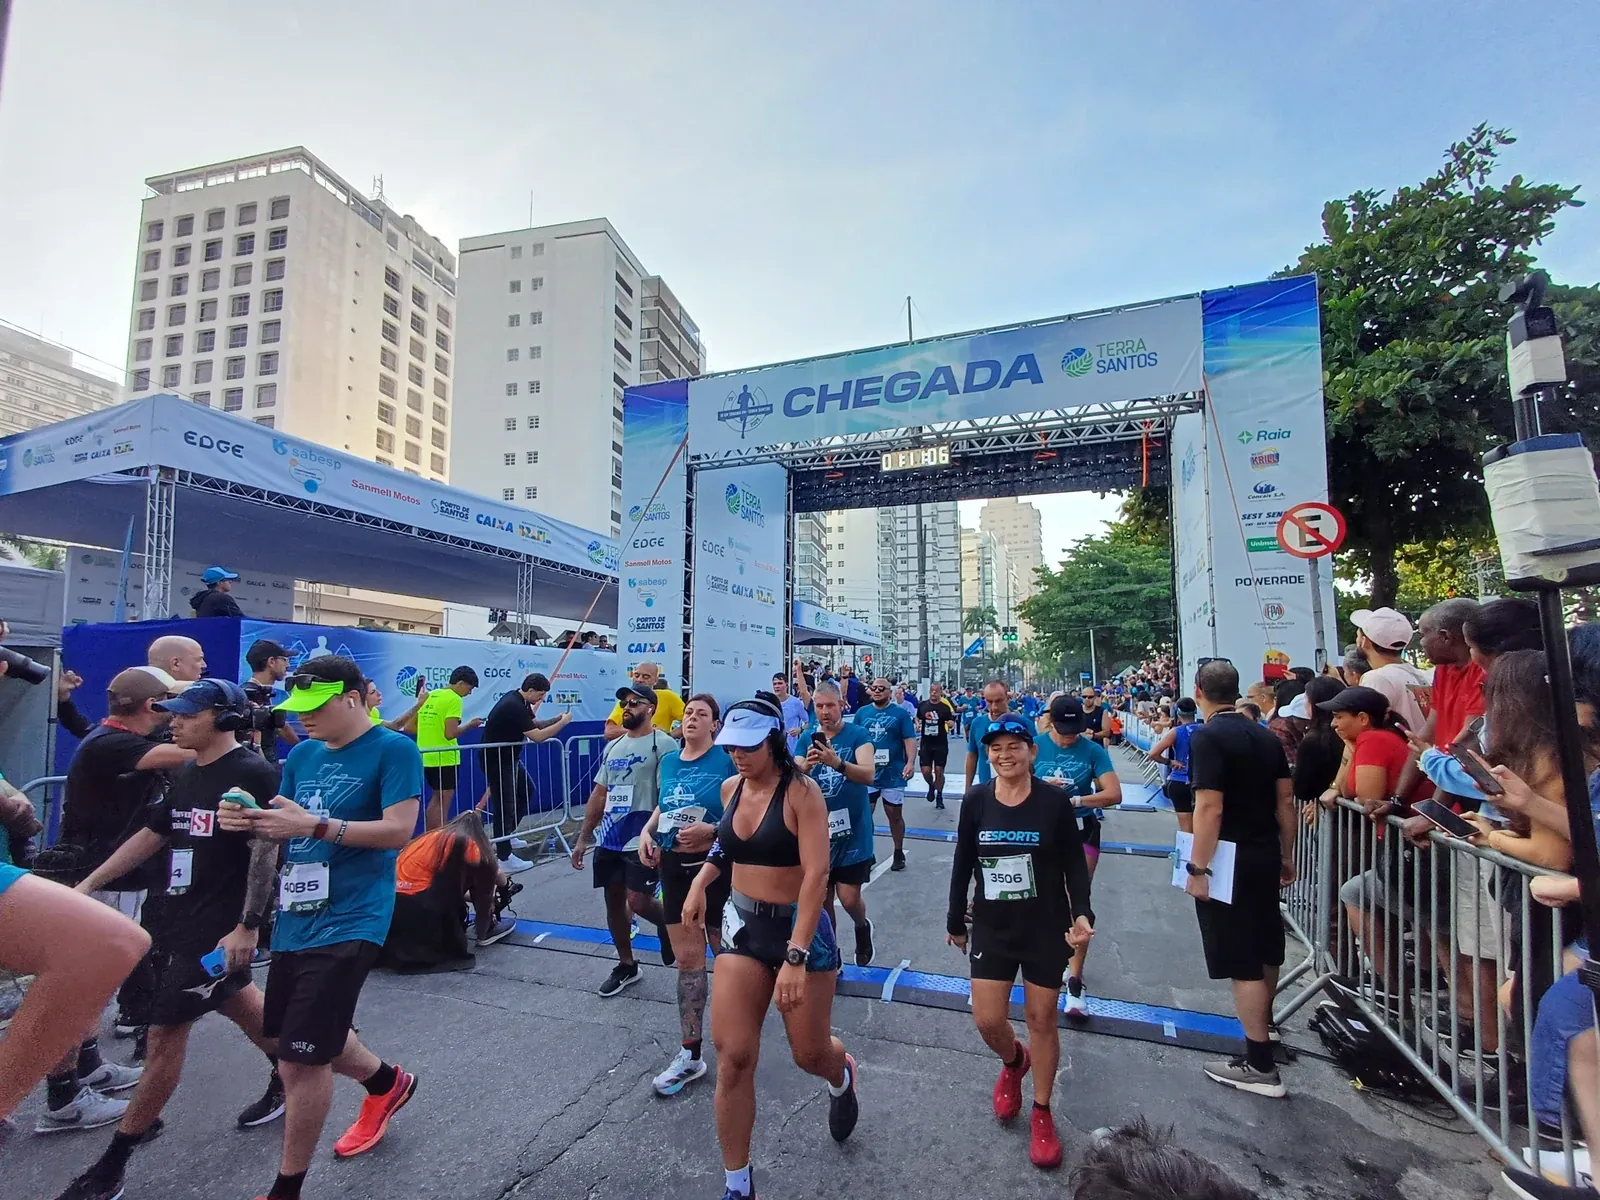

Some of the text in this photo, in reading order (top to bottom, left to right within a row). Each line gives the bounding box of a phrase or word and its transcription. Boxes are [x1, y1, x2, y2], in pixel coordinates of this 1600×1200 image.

[1096, 337, 1147, 358] TERRA
[1096, 352, 1158, 374] SANTOS
[783, 353, 1044, 418] CHEGADA
[64, 435, 84, 446] EDGE
[1256, 428, 1291, 442] Raia
[184, 431, 244, 458] EDGE
[292, 447, 342, 470] sabesp
[1251, 455, 1278, 465] KRILL
[352, 479, 421, 506] Sanmell Motos
[440, 500, 461, 511] PORTO
[741, 489, 762, 512] TERRA
[440, 506, 469, 520] SANTOS
[644, 511, 671, 522] SANTOS
[740, 504, 765, 529] SANTOS
[1241, 510, 1285, 520] SEST SEN
[476, 513, 514, 533] CAIXA
[1298, 514, 1322, 547] E
[632, 537, 665, 549] EDGE
[702, 540, 725, 557] EDGE
[624, 560, 651, 568] Sanmell
[638, 578, 668, 587] sabesp
[711, 581, 729, 592] SANTOS
[1235, 575, 1306, 587] POWERADE
[732, 584, 754, 599] CAIXA
[636, 622, 665, 630] SANTOS
[627, 642, 666, 654] CAIXA
[425, 667, 453, 681] TERR
[484, 668, 512, 678] EDGE
[666, 812, 697, 824] 5295
[978, 830, 1040, 842] GESPORTS
[990, 872, 1023, 884] 3506
